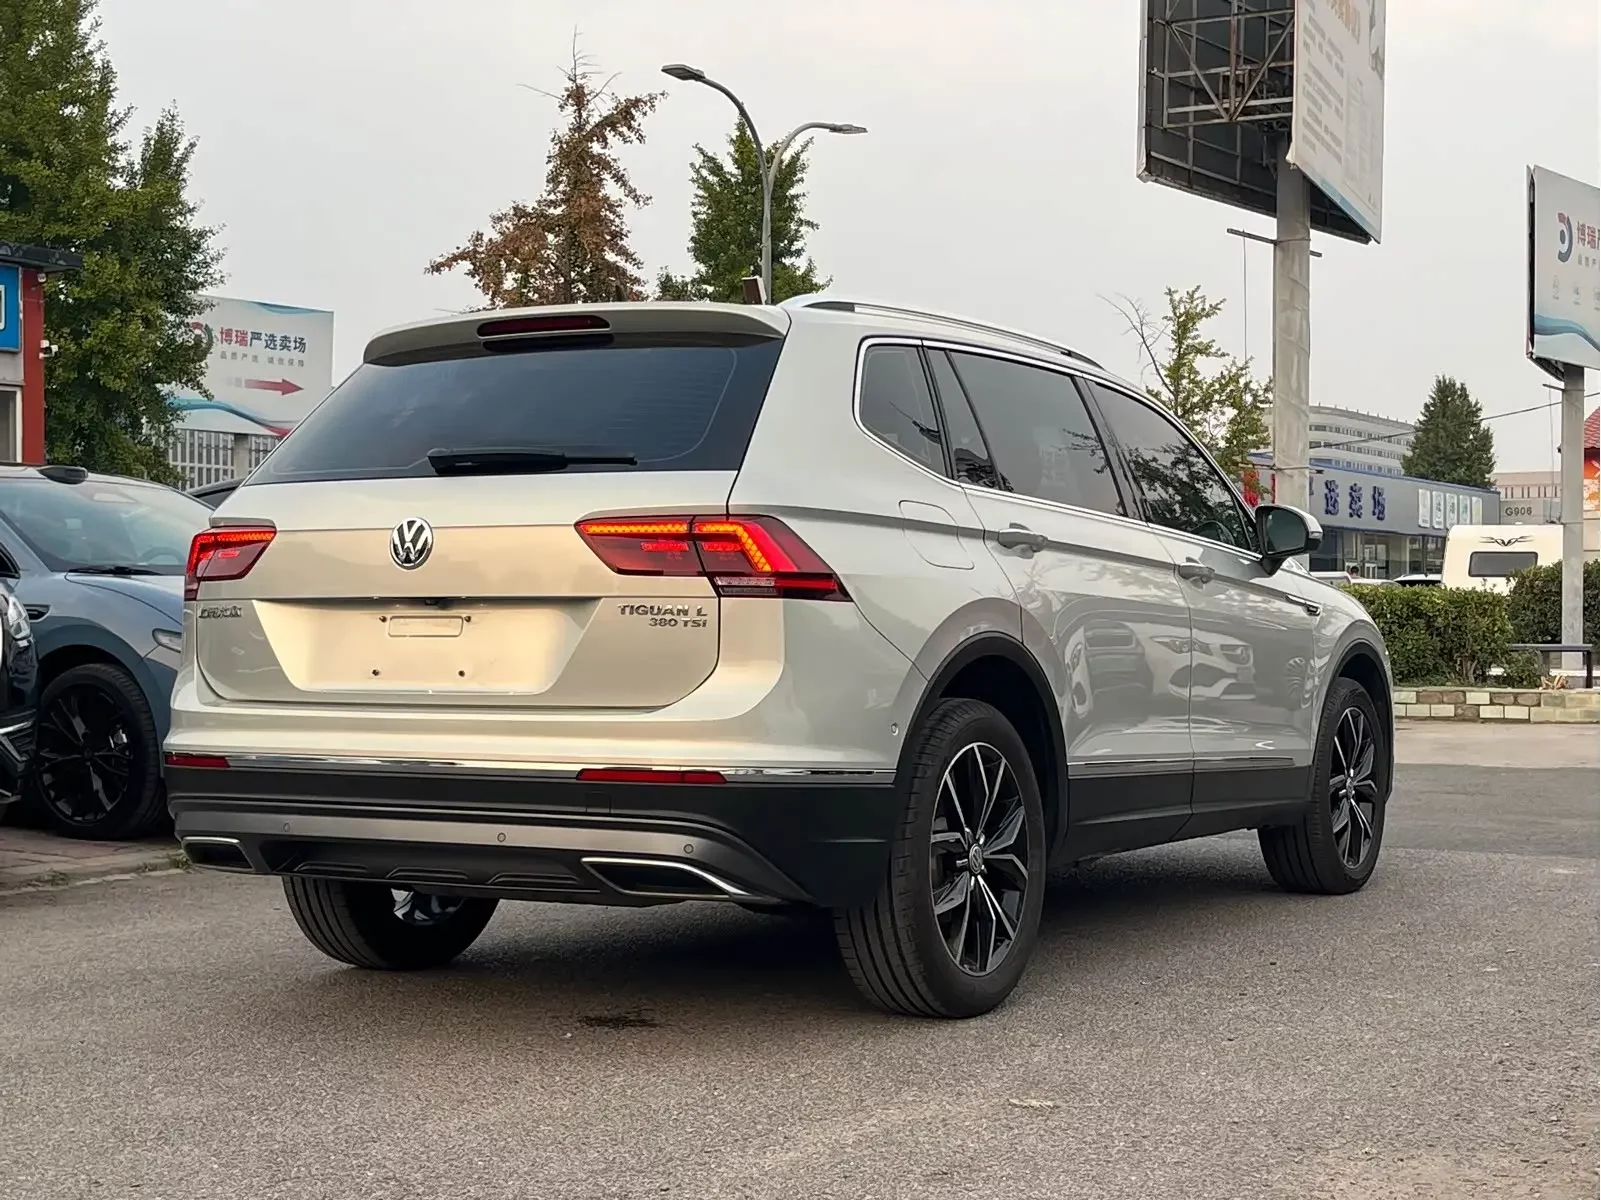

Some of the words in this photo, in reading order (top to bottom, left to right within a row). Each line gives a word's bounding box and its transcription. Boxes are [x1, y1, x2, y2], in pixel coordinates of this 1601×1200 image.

[1576, 220, 1600, 250] 博瑞
[219, 326, 306, 353] 博瑞严选卖场
[617, 604, 689, 616] TIGUAN
[696, 605, 708, 617] L
[648, 617, 679, 627] 380
